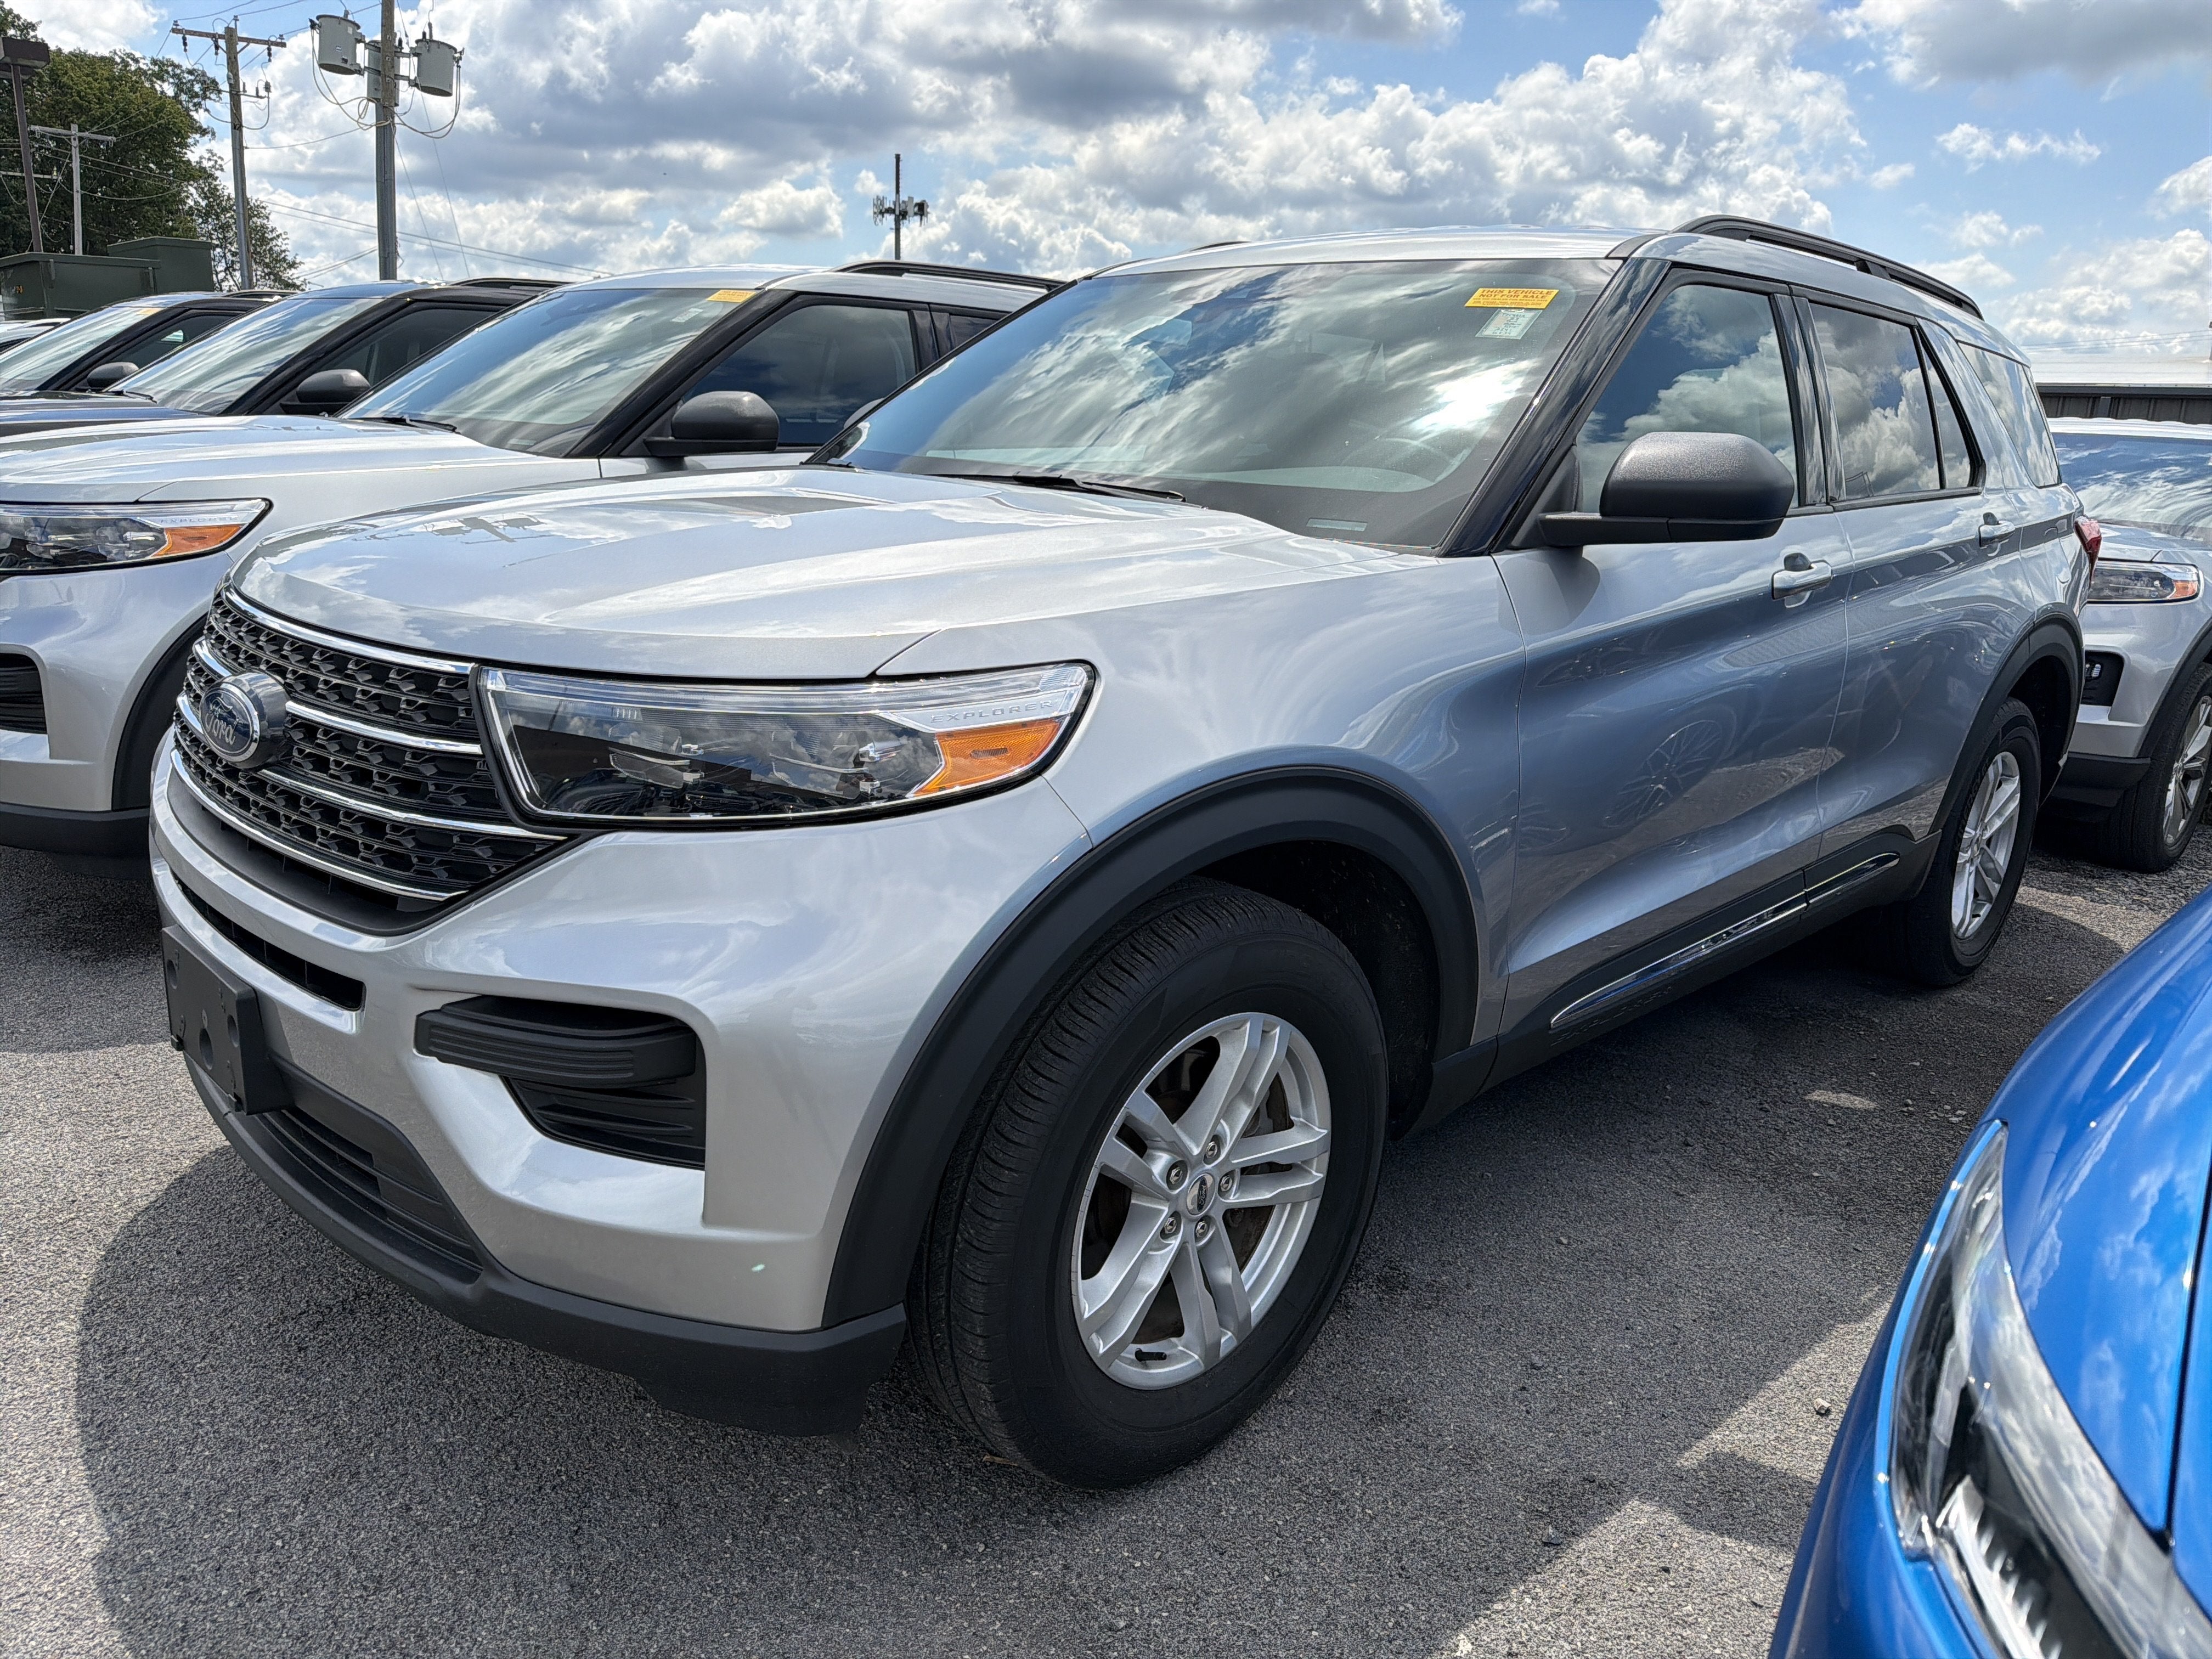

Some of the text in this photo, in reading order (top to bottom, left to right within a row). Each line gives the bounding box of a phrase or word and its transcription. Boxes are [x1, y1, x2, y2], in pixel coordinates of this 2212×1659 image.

[205, 696, 239, 746] Ford
[930, 700, 1053, 724] EXPLORER
[1198, 1184, 1206, 1205] Ford
